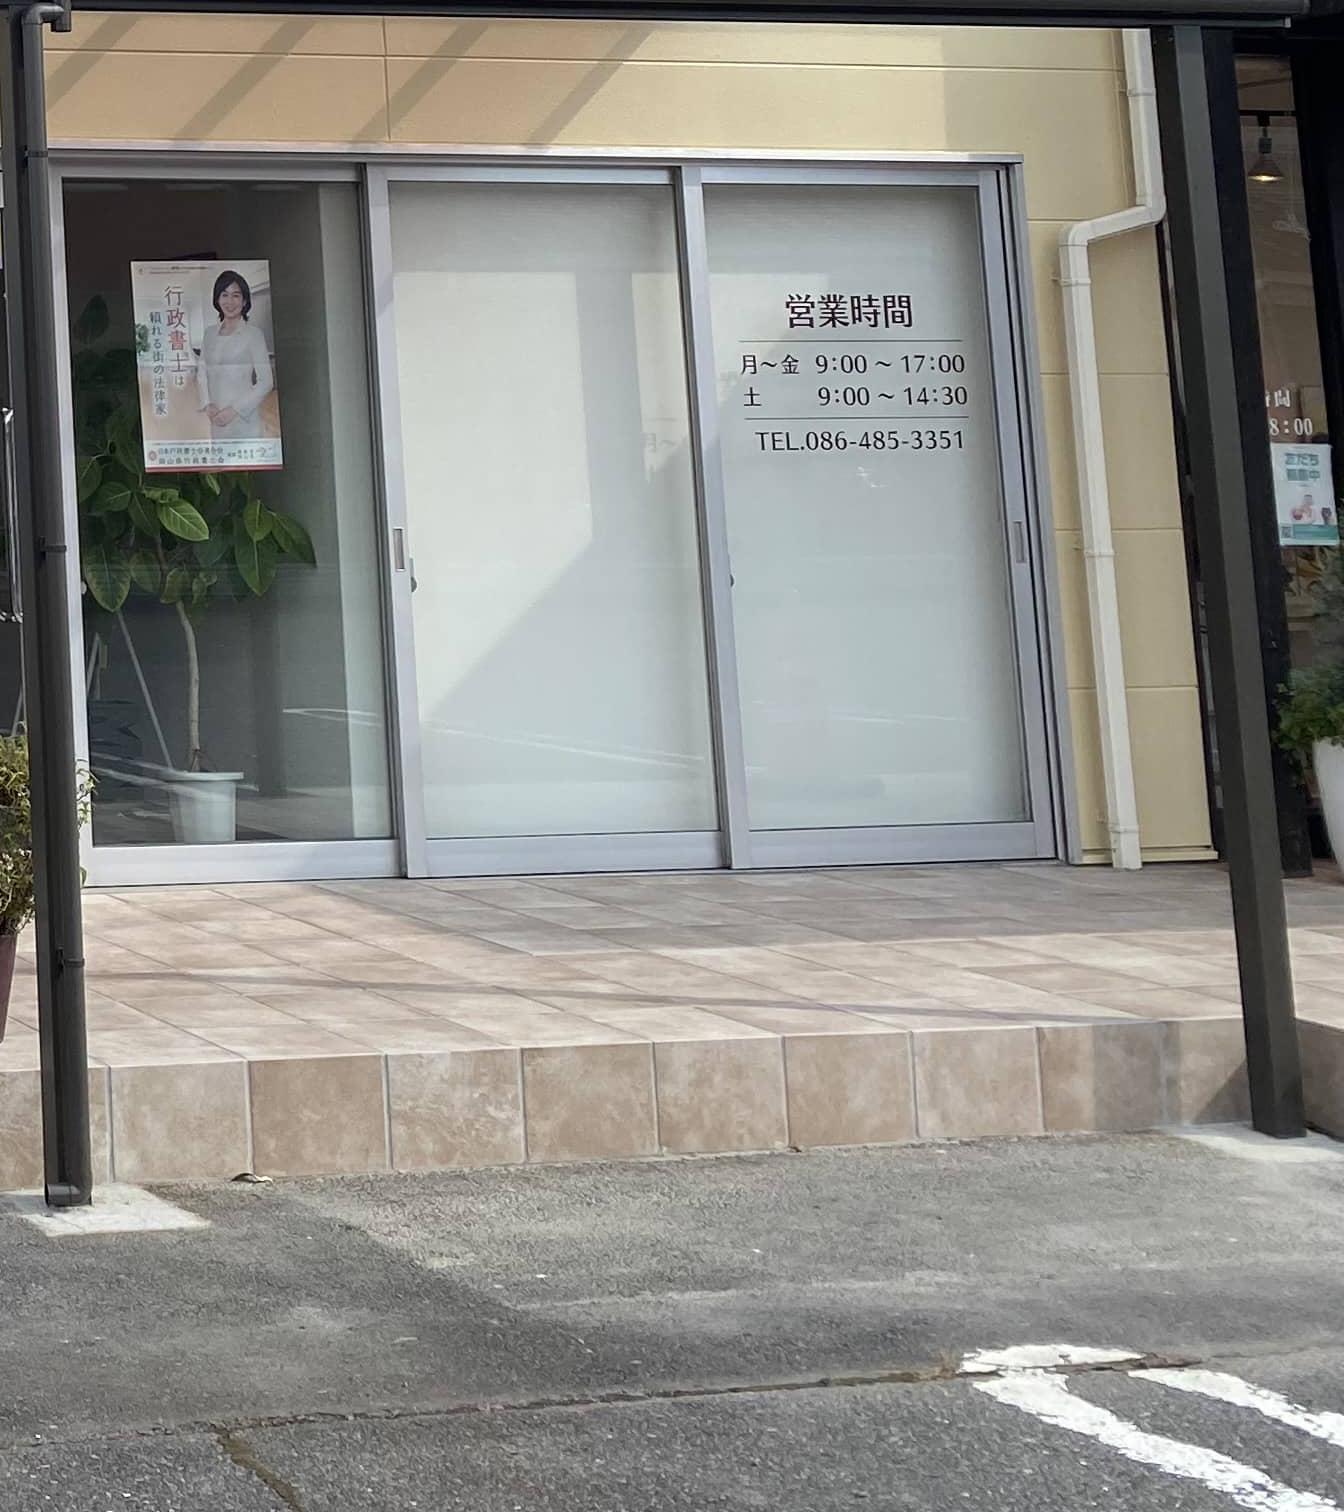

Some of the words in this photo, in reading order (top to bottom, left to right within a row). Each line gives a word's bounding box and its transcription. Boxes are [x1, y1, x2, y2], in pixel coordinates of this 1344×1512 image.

[785, 293, 913, 329] 営業時間
[164, 285, 189, 388] 行政書士は
[148, 311, 168, 416] 頼れる街の法律家
[743, 387, 762, 407] 土
[754, 430, 964, 451] TEL.086-485-3351
